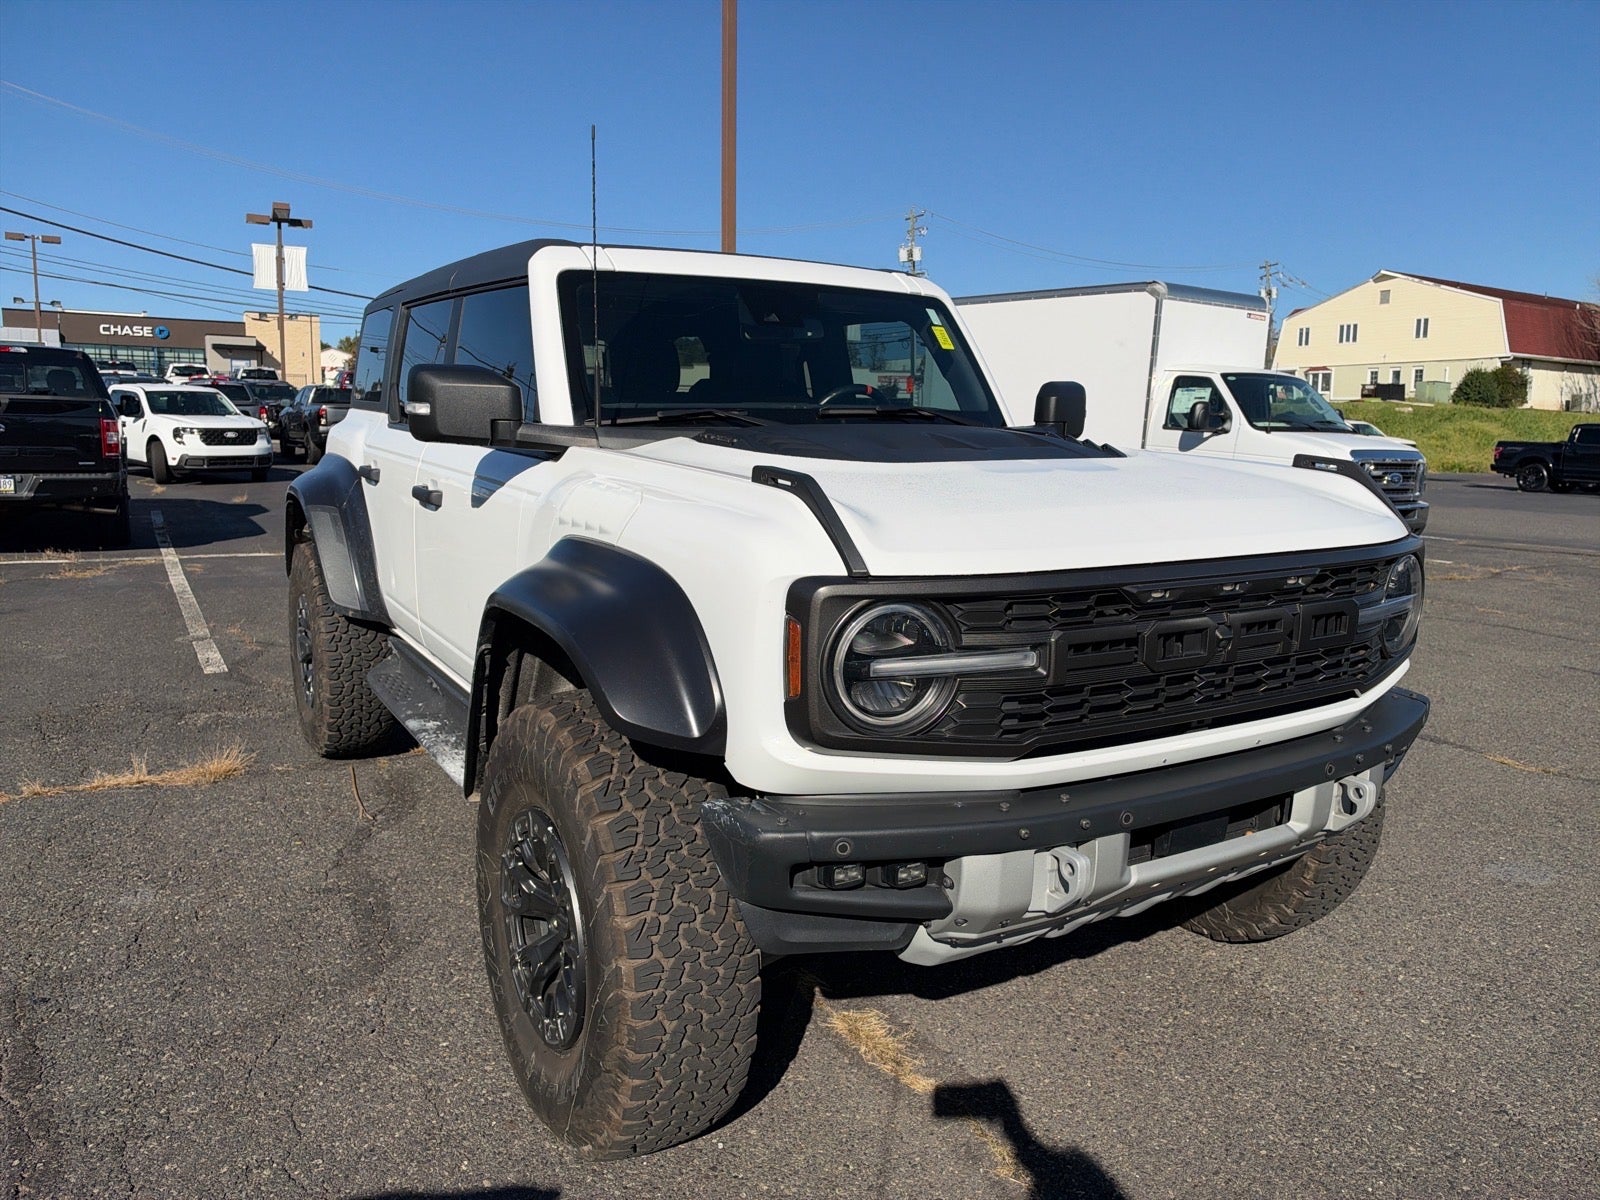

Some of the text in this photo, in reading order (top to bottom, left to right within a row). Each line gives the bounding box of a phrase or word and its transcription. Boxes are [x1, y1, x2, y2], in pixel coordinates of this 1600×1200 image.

[99, 324, 153, 337] CHASE
[0, 479, 13, 490] 89
[1049, 600, 1359, 685] FORD
